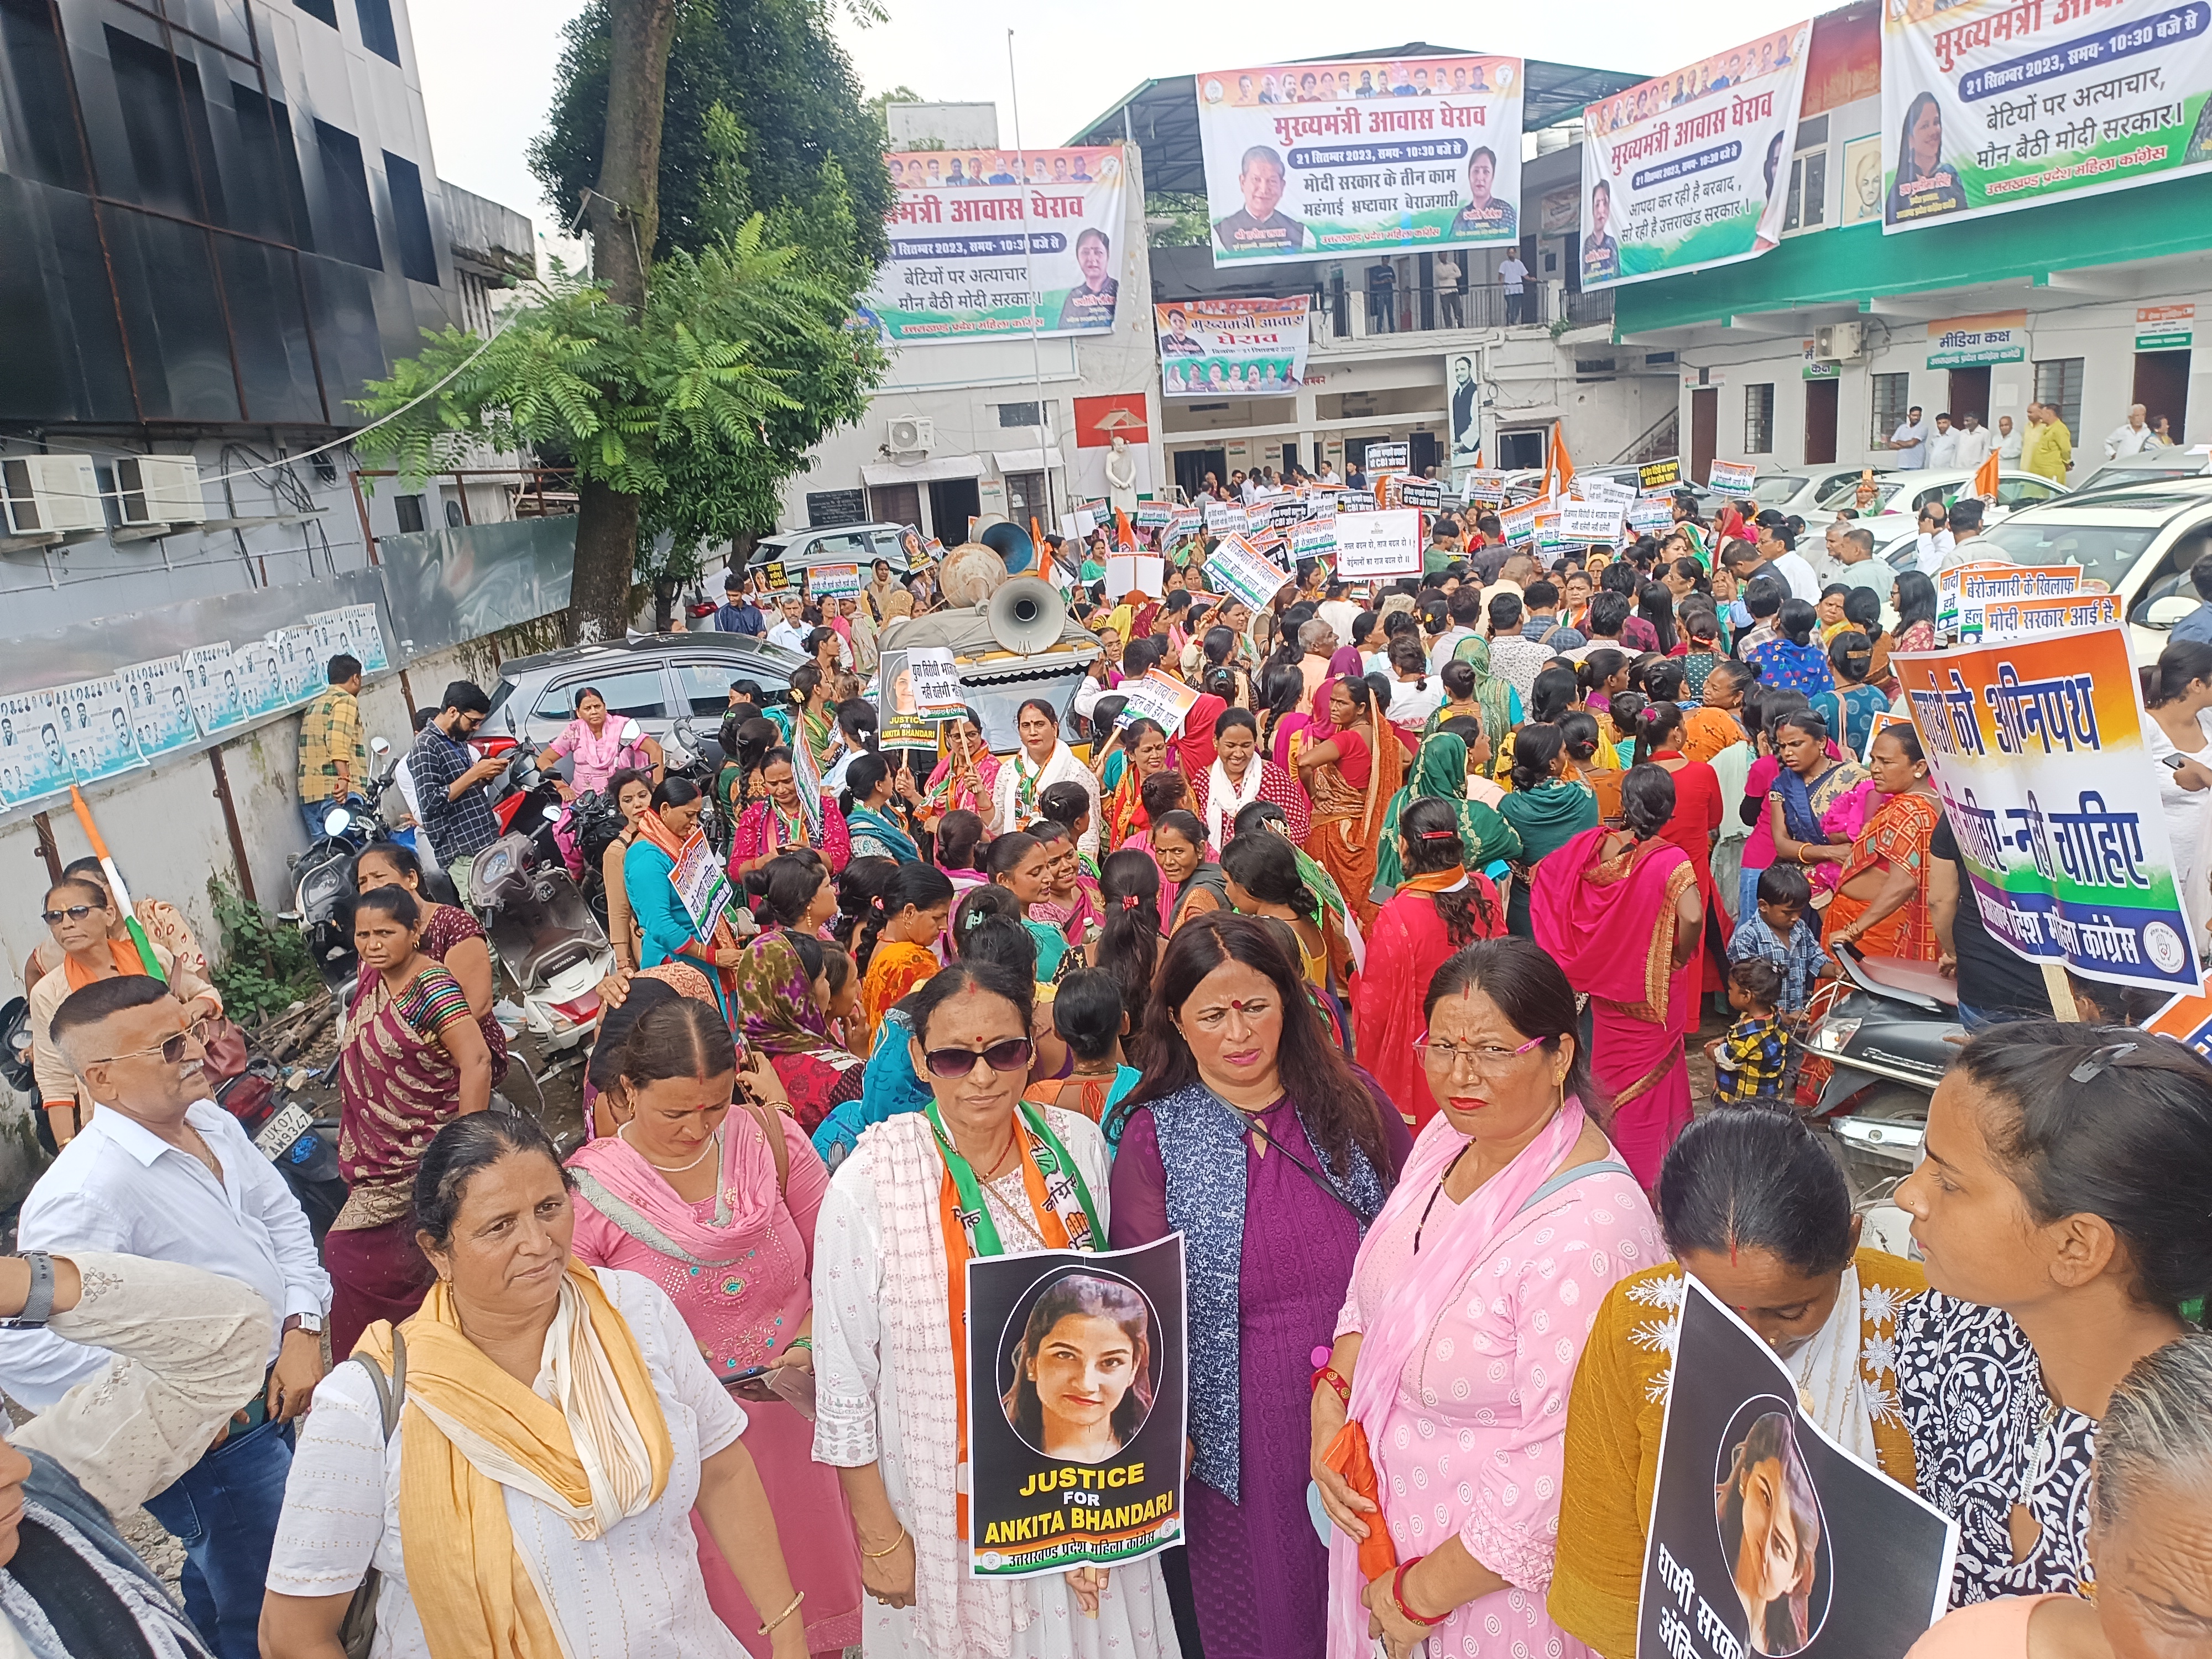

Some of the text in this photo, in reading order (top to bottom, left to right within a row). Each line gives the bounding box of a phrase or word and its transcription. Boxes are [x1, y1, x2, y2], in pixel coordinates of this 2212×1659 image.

[1966, 9, 2198, 95] 21 सितम्बर 2023, समय- 10:30 बजे से
[1986, 67, 2165, 131] बेटियों पर अत्याचार,
[1369, 108, 1434, 133] आवास
[1438, 101, 1486, 128] घेराव
[1673, 108, 1726, 147] आवास
[1731, 91, 1773, 126] घेराव
[1296, 153, 1310, 164] 21
[1312, 150, 1344, 164] सितम्बर
[1346, 149, 1376, 163] 2023,
[1407, 145, 1434, 158] 10:30
[1436, 144, 1451, 157] बजे
[1452, 142, 1461, 155] से
[1976, 141, 2010, 169] मौन
[2016, 131, 2049, 164] बैठी
[2055, 118, 2097, 152] मोदी
[1303, 168, 1456, 191] मोदी सरकार के तीन काम
[1985, 145, 2167, 195] उत्तराखण्ड प्रदेश महिला कांग्रेस
[950, 190, 1085, 222] आवास घेराव
[1303, 197, 1344, 217] महंगाई
[1352, 197, 1398, 215] भ्रष्टाचार
[1629, 176, 1735, 217] आपदा कर रही है बरबाद
[1622, 201, 1740, 242] सो रही है उत्तराखंड सरकार
[1321, 226, 1440, 244] उत्तराखण्ड प्रदेश महिला कांग्रेस
[935, 242, 967, 255] 2023,
[904, 266, 1027, 286] बेटियों पर अत्याचार
[898, 289, 987, 312] मौन बैठी मोदी
[901, 319, 1009, 335] उत्तराखण्ड प्रदेश महिला
[1217, 332, 1279, 345] घेराव
[1940, 330, 2011, 348] मीडिया कक्ष
[1376, 458, 1387, 467] CBI
[1347, 503, 1359, 512] CBI
[1408, 496, 1419, 504] CBI
[1275, 519, 1285, 527] CBI
[1401, 537, 1406, 546] दो
[1397, 554, 1402, 563] दो
[1943, 571, 1958, 592] वादों
[1966, 574, 2075, 598] बेरोजगारी के खिलाफ
[1989, 599, 2118, 631] मोदी सरकार आई है.
[922, 660, 940, 677] विरोधी
[932, 681, 951, 699] चलेगी
[889, 717, 925, 725] JUSTICE
[1945, 670, 1985, 757] को
[1985, 664, 2101, 753] अग्निपथ
[881, 728, 935, 739] ANKITA BHANDARI
[2048, 791, 2150, 889] चाहिए
[2006, 900, 2044, 945] प्रदेश
[2042, 905, 2081, 957] महिला
[2078, 914, 2141, 964] कांग्रेस
[264, 1112, 295, 1140] UK07
[269, 1114, 309, 1156] AW9347
[1041, 1172, 1078, 1212] कांग्रेस
[1020, 1463, 1145, 1496] JUSTICE
[1063, 1491, 1100, 1507] FOR
[985, 1490, 1173, 1544] ANKITA BHANDARI
[1009, 1528, 1155, 1568] उत्तराखण्ड प्रदेश महिला कांग्रेस
[1658, 1542, 1695, 1615] धामी
